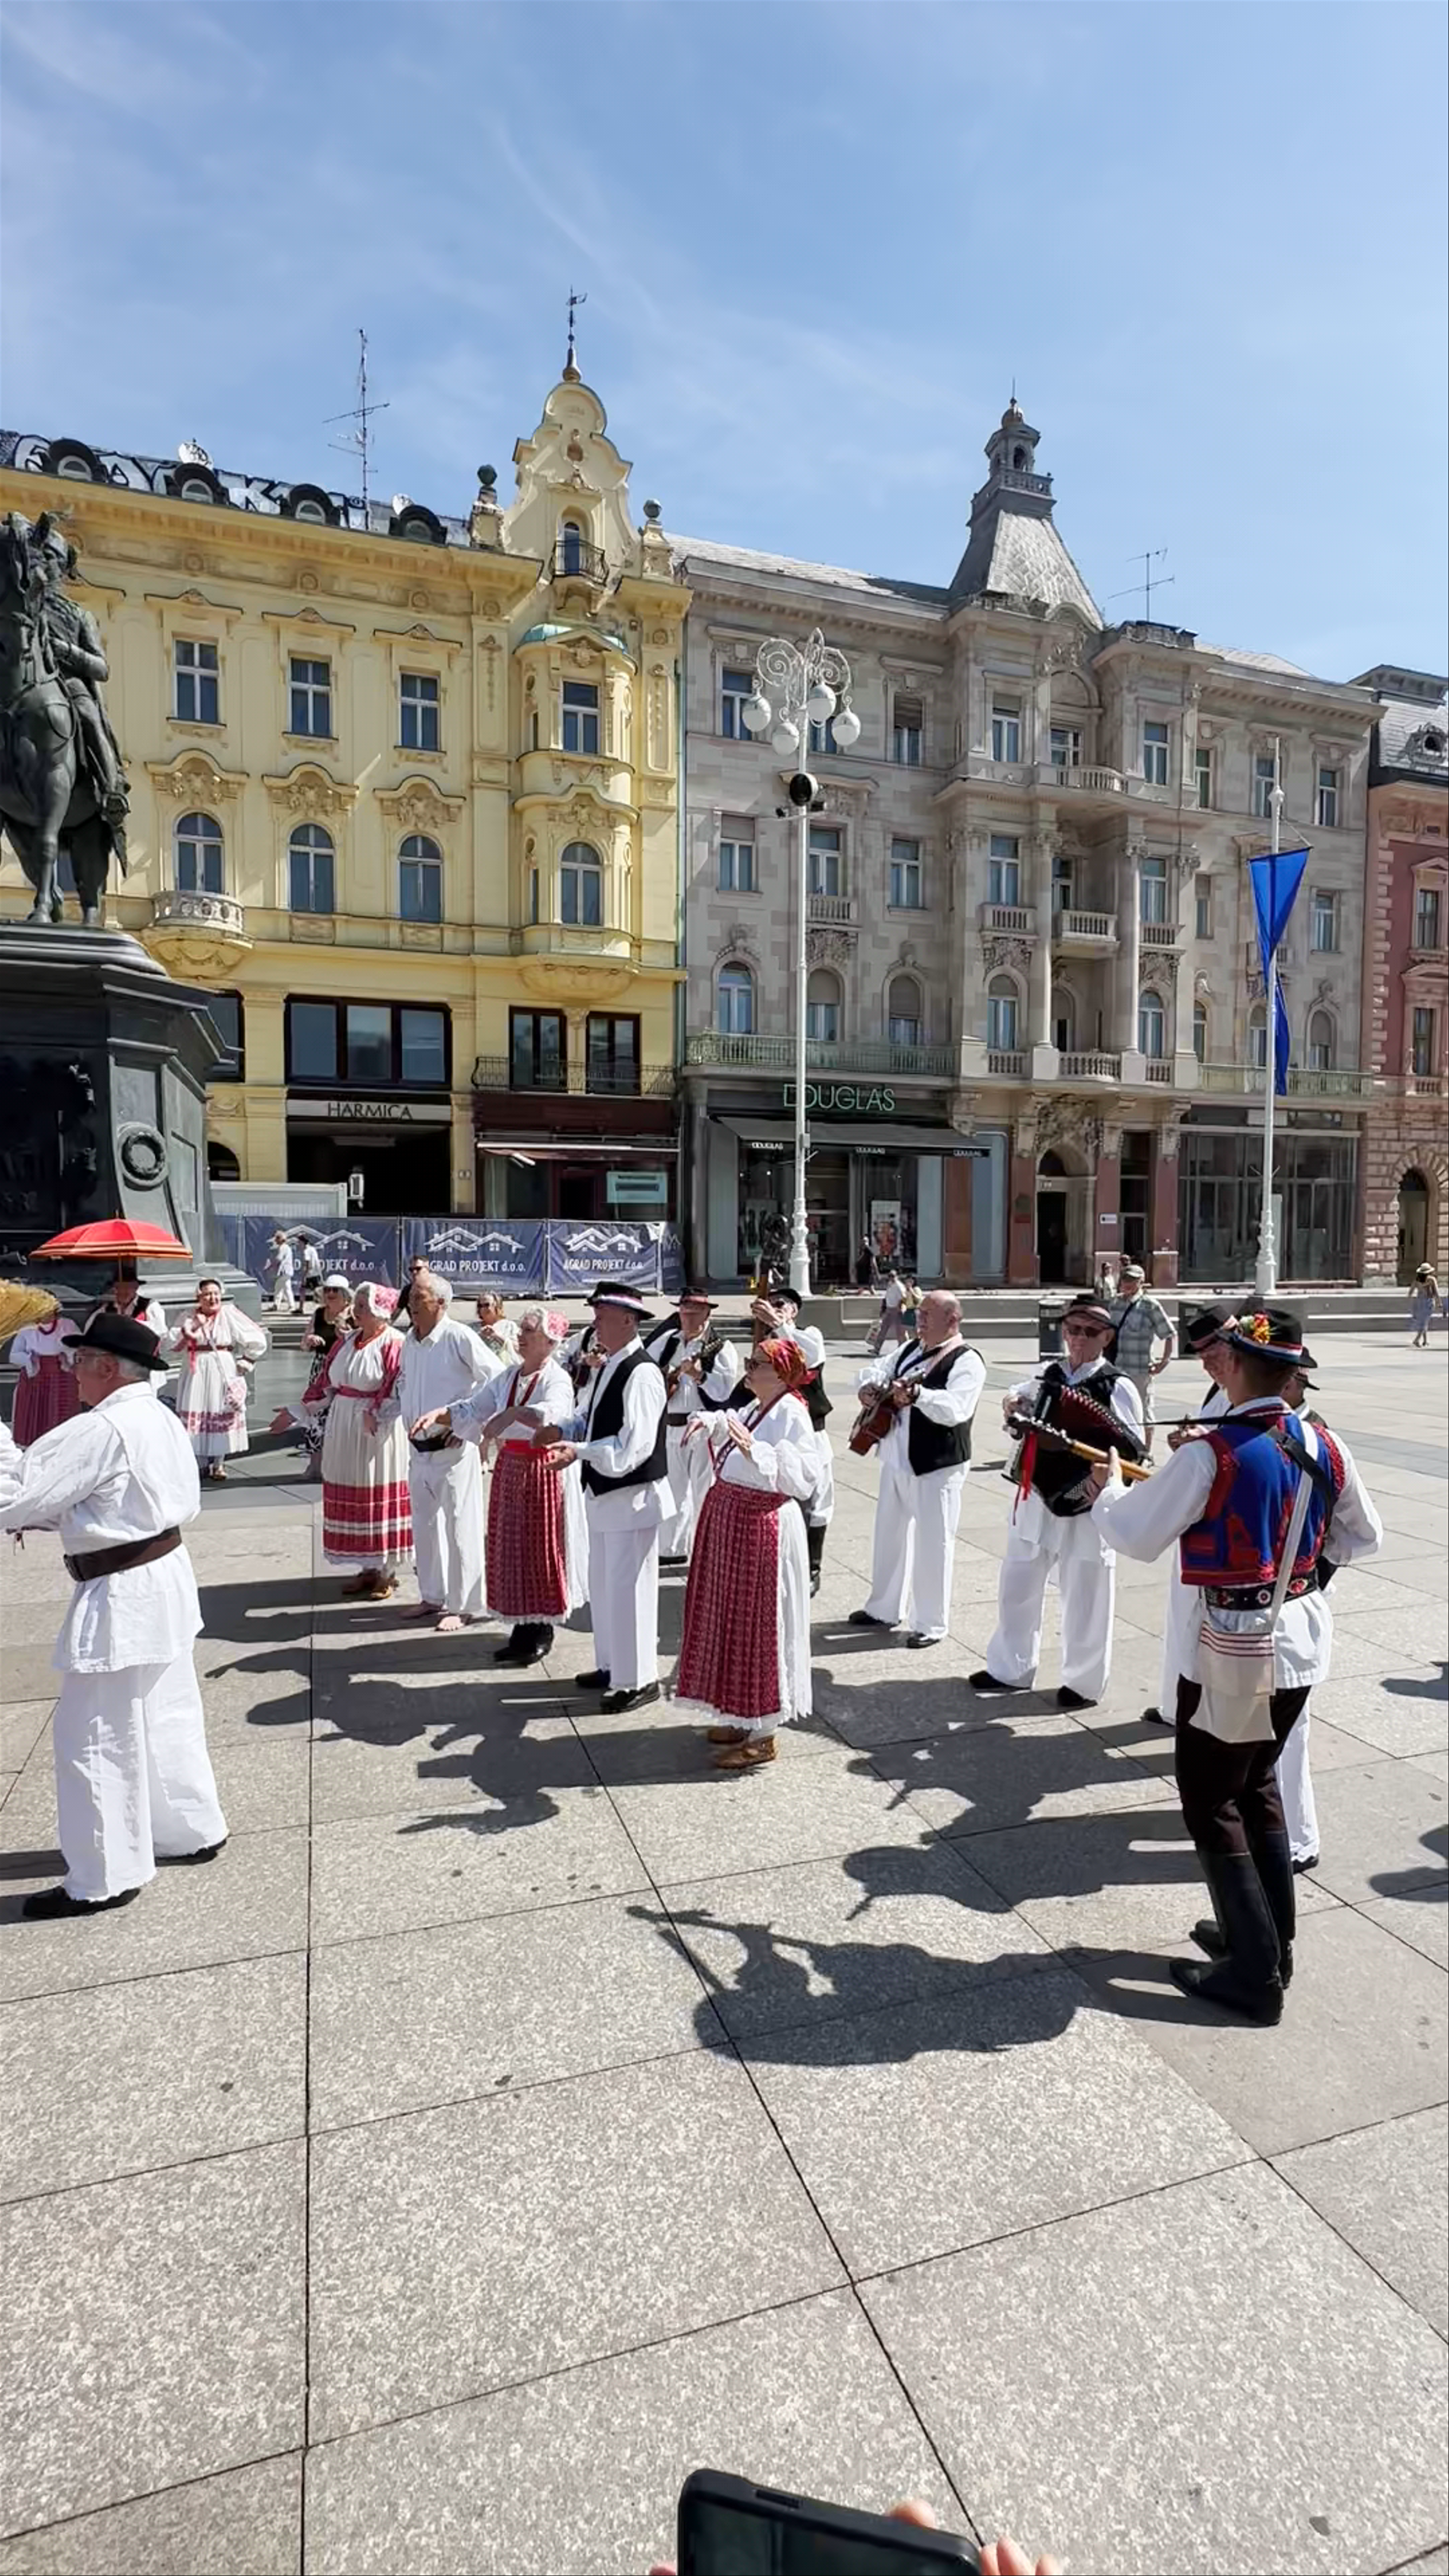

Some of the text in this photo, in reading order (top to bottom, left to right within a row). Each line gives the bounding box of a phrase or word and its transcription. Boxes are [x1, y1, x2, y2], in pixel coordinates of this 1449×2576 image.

[784, 1083, 895, 1111] DOUGLAS
[328, 1102, 413, 1121] HARMICA
[429, 1260, 526, 1273] GRAD PROJEKT d.o.o.
[592, 1259, 624, 1272] PROJEKT
